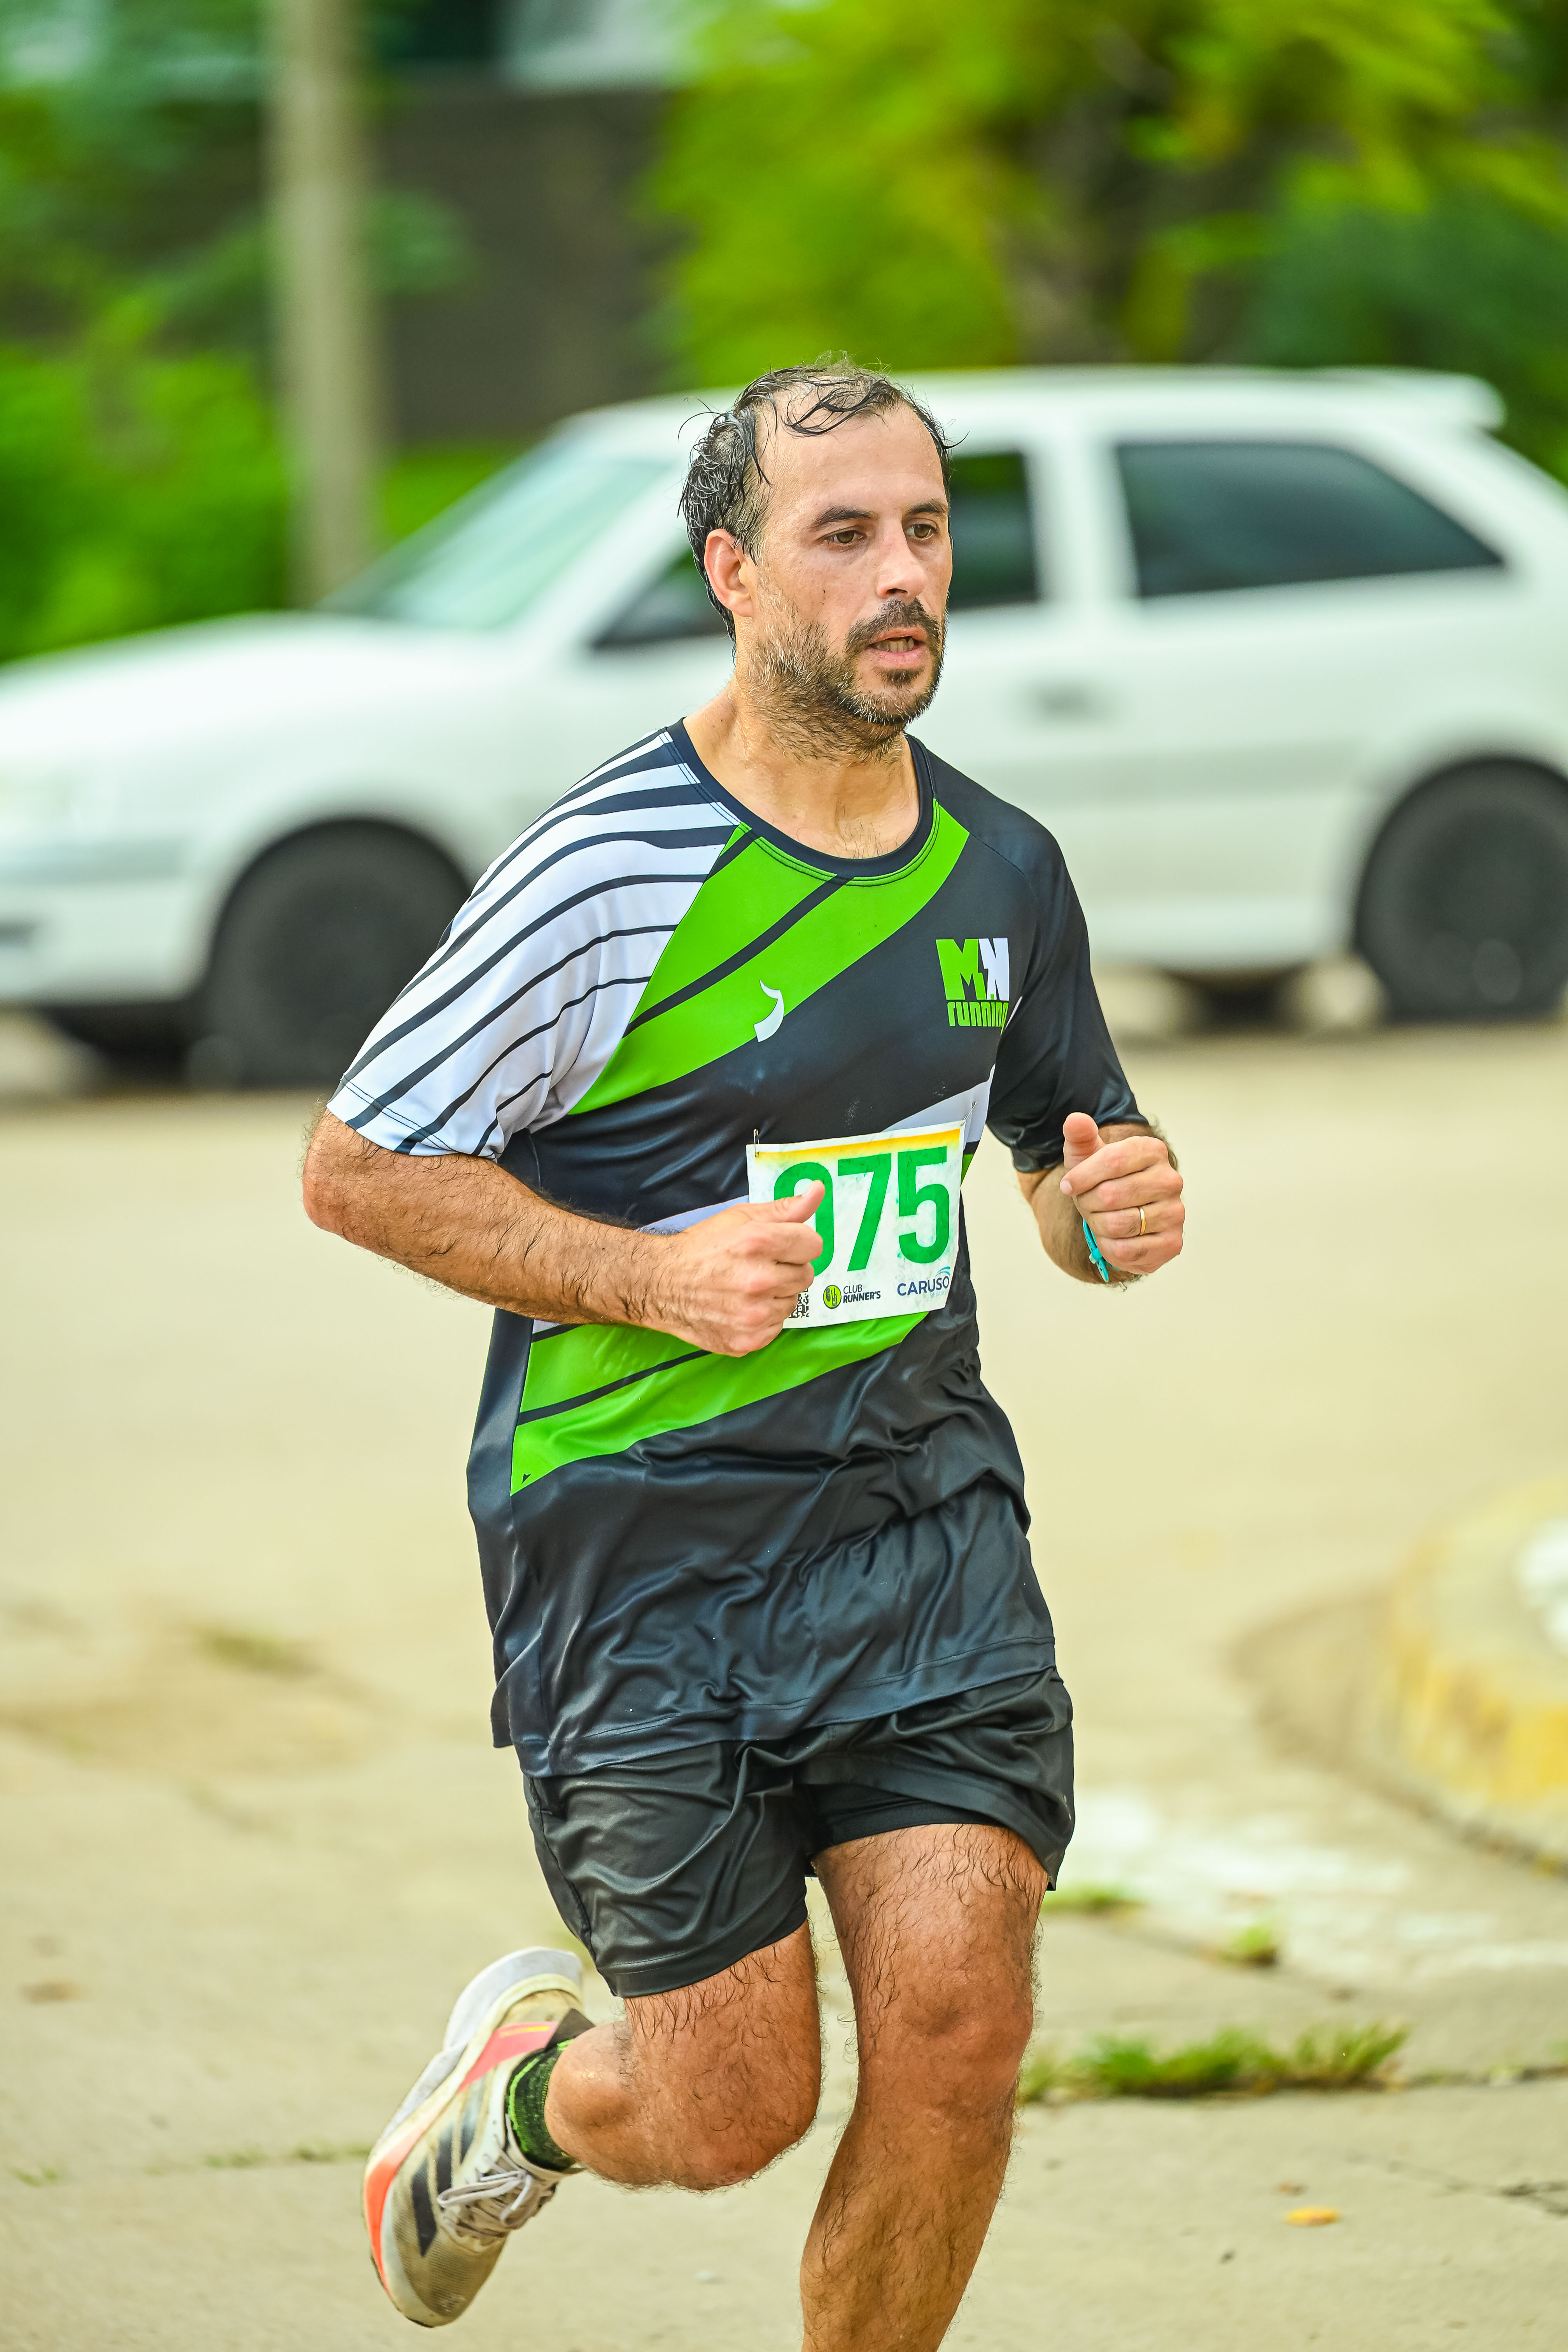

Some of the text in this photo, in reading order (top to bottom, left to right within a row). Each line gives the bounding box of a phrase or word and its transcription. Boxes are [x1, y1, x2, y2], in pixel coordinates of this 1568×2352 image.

[947, 994, 1009, 1036] running
[843, 1284, 863, 1294] CLUB
[897, 1276, 949, 1296] CARUSO
[843, 1291, 881, 1304] RUNNER'S
